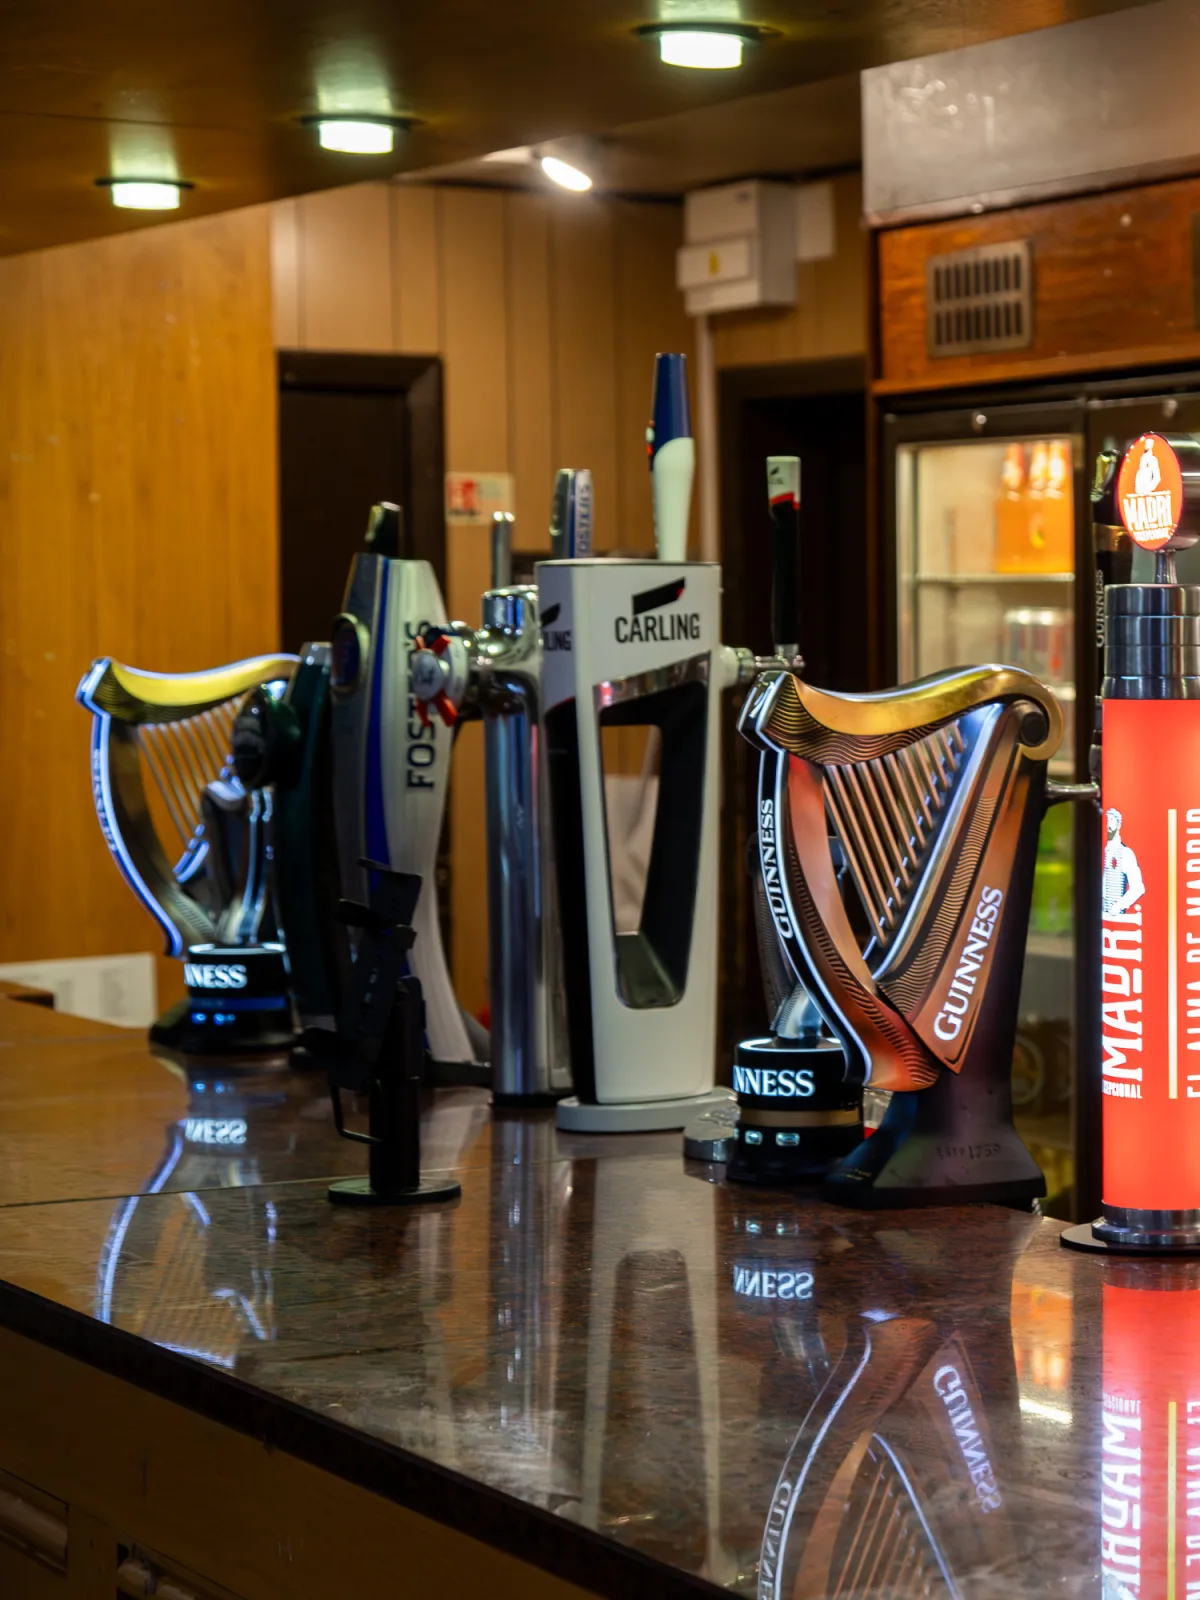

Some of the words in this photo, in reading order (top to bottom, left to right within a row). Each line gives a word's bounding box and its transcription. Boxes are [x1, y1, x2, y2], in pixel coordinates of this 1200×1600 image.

[614, 613, 701, 643] CARLING
[761, 798, 794, 939] GUINNESS
[933, 885, 1003, 1041] GUINNESS
